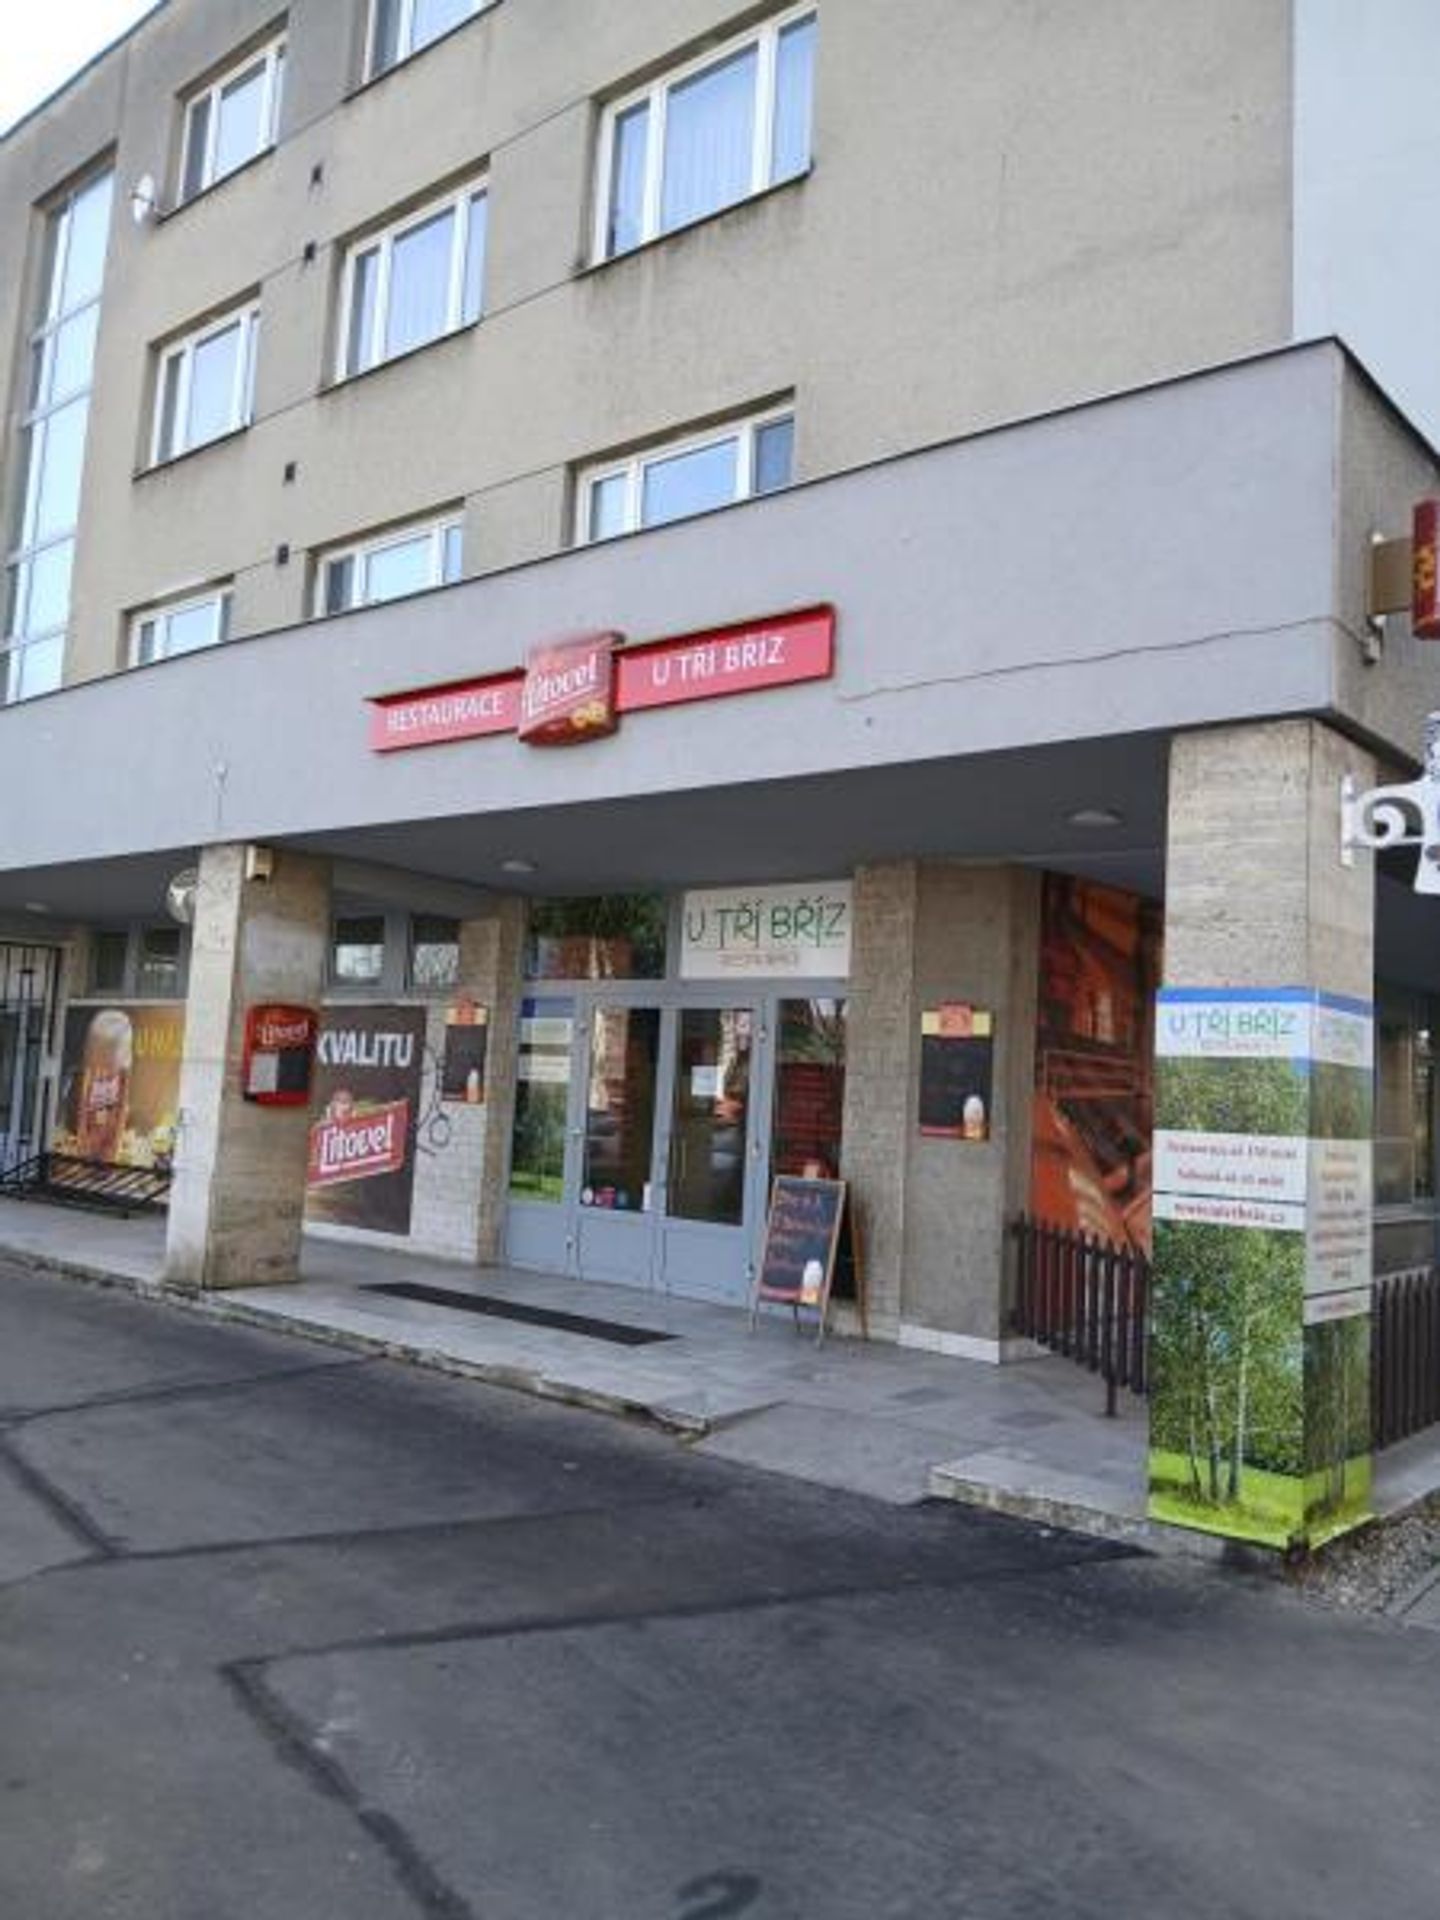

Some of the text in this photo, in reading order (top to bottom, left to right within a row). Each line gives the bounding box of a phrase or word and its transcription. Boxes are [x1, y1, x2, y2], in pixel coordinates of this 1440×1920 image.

[522, 651, 598, 718] Litovel
[652, 658, 670, 687] U
[387, 691, 504, 732] RESTAURACE
[687, 908, 706, 943] U
[771, 895, 847, 949] BŘÍZ
[1169, 1010, 1186, 1034] U
[317, 1030, 415, 1068] KVALITU
[318, 1112, 395, 1173] Litovel
